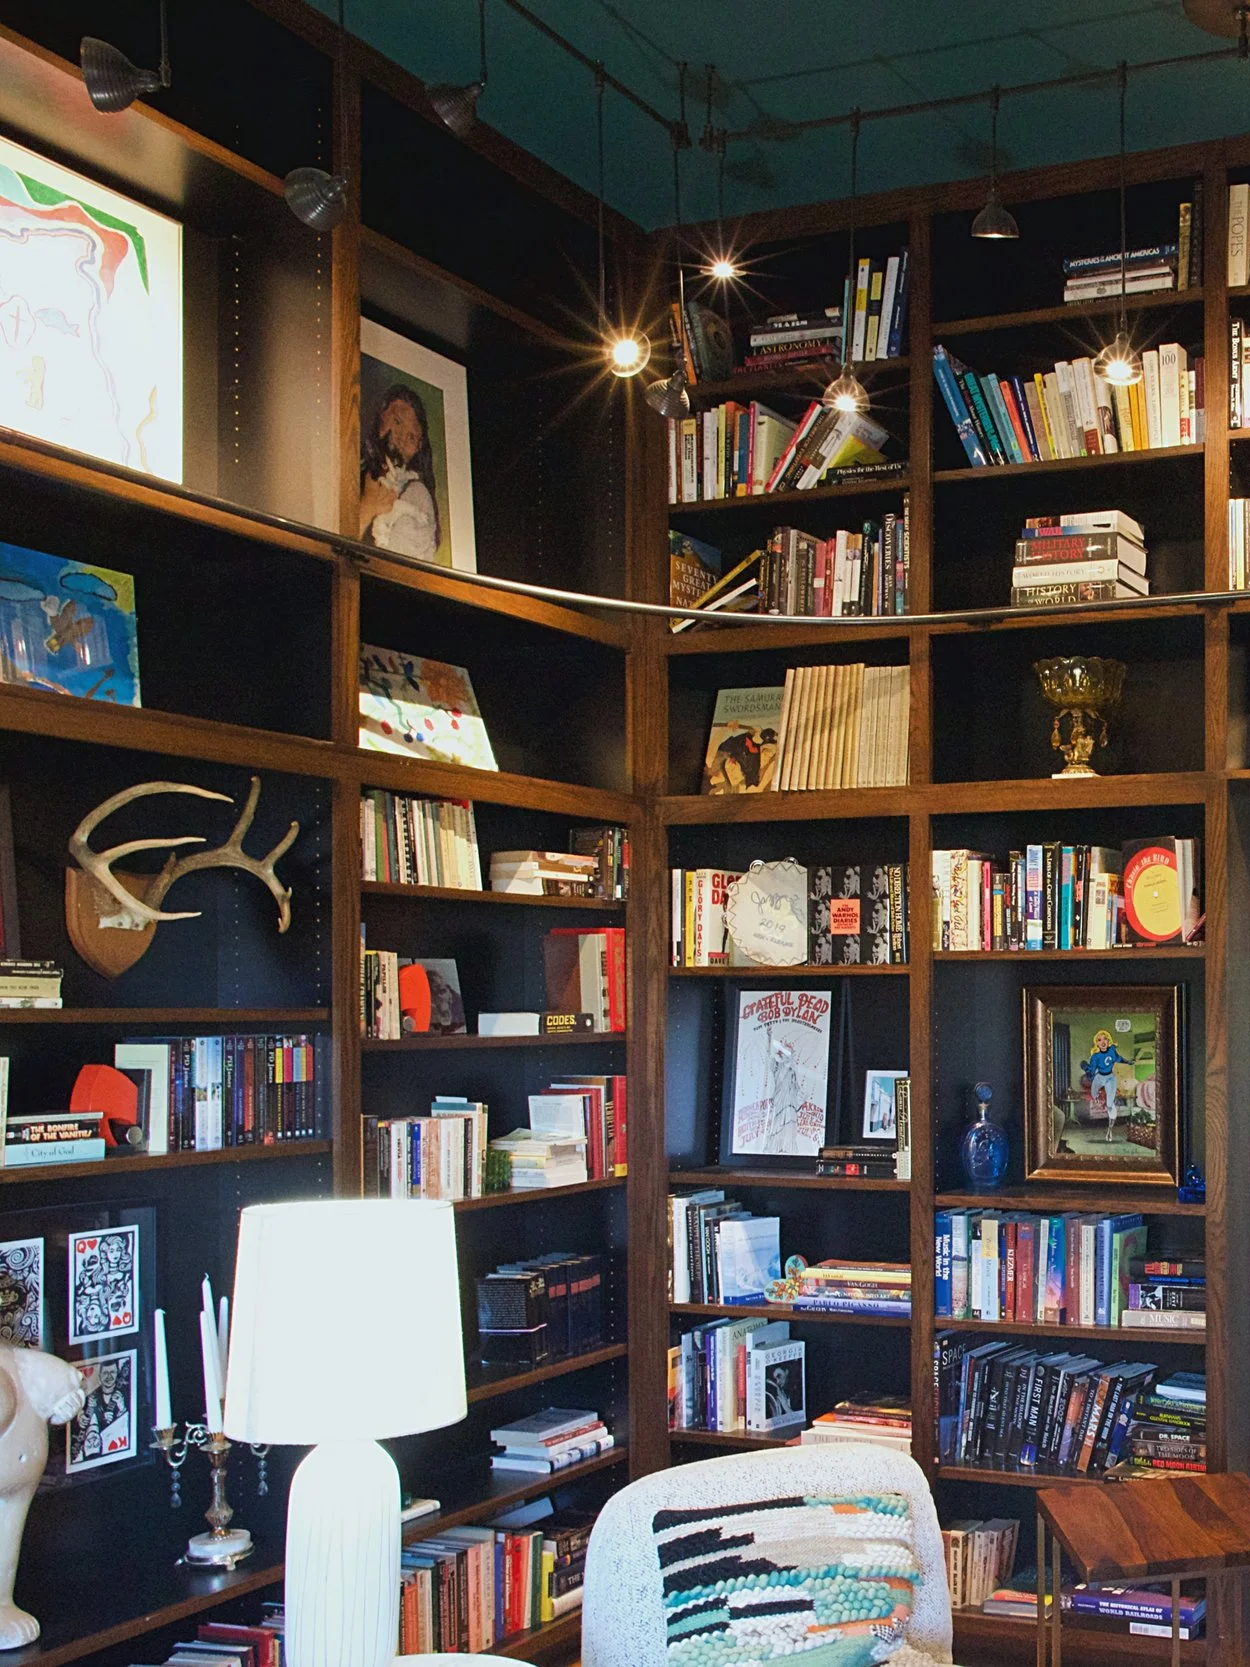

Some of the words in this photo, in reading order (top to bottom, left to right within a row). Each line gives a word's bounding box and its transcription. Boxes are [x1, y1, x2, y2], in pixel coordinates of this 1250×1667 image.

[1232, 322, 1241, 337] THE
[760, 338, 822, 356] ASTRONOMY
[1232, 337, 1241, 360] BONUS
[1161, 353, 1176, 365] 100
[1231, 360, 1240, 379] ARMY
[836, 467, 856, 476] Physics
[884, 513, 895, 571] DISCOVERIES
[1031, 537, 1085, 549] MILITARY
[674, 561, 719, 584] SEVENTY
[1052, 568, 1085, 577] HISTORY
[682, 574, 712, 591] GREAT
[1026, 583, 1077, 596] HISTORY
[724, 696, 742, 704] THE
[724, 703, 780, 713] SWORDSMAN
[1028, 849, 1039, 866] JIMMY
[1152, 853, 1170, 865] BIRD
[760, 918, 787, 933] 2019
[741, 992, 794, 1020] GRATEFUL
[798, 993, 830, 1014] DEAD
[757, 1006, 781, 1023] BOB
[782, 1007, 823, 1024] DYLAN
[605, 1101, 614, 1138] VENDETTA
[30, 1124, 42, 1133] THE
[45, 1123, 79, 1133] BONFIRE
[30, 1133, 42, 1142] OF
[44, 1132, 60, 1141] THE
[61, 1130, 92, 1140] VANITIES
[31, 1149, 47, 1158] City
[56, 1146, 75, 1156] God
[76, 1239, 86, 1253] Q
[935, 1236, 943, 1251] New
[942, 1234, 950, 1256] Music
[935, 1253, 943, 1277] World
[942, 1257, 950, 1265] in
[942, 1265, 950, 1280] the
[859, 1281, 878, 1289] GOGH
[813, 1300, 839, 1308] PABLO
[842, 1301, 879, 1309] PICASSO
[121, 1312, 132, 1326] Q
[1148, 1314, 1179, 1322] MUSIC
[731, 1324, 768, 1341] ANATOMY
[1034, 1378, 1043, 1405] FIRST
[1029, 1406, 1039, 1432] MAN
[118, 1435, 128, 1449] K
[568, 1575, 582, 1585] THE
[1110, 1602, 1139, 1610] HISTORICAL
[1099, 1607, 1123, 1616] WORLD
[1124, 1611, 1164, 1620] RAILROADS
